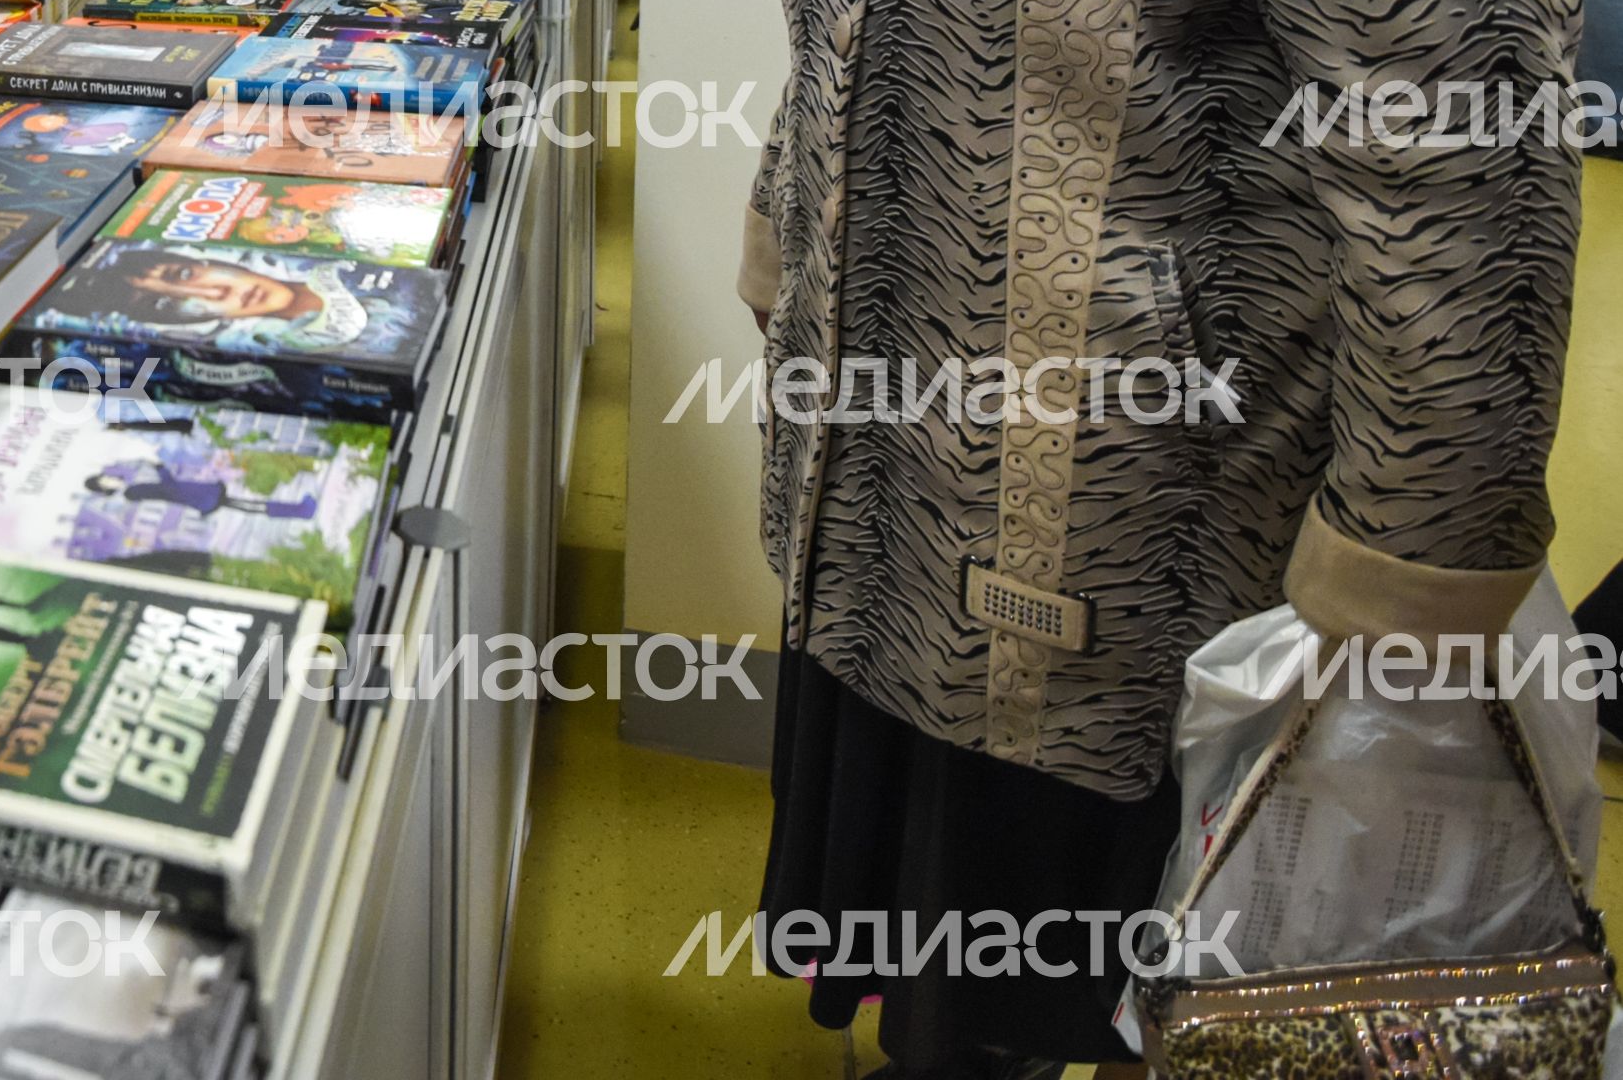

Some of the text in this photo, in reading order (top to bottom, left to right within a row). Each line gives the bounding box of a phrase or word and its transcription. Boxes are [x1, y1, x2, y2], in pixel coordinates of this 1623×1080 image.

[9, 77, 48, 90] СЕКРЕТ
[51, 79, 78, 92] ДОМА
[81, 82, 88, 93] С
[90, 82, 166, 99] ПРИВИДЕНИЯМИ
[162, 177, 248, 242] КНОПА
[118, 605, 254, 804] БЕЛИЗНА
